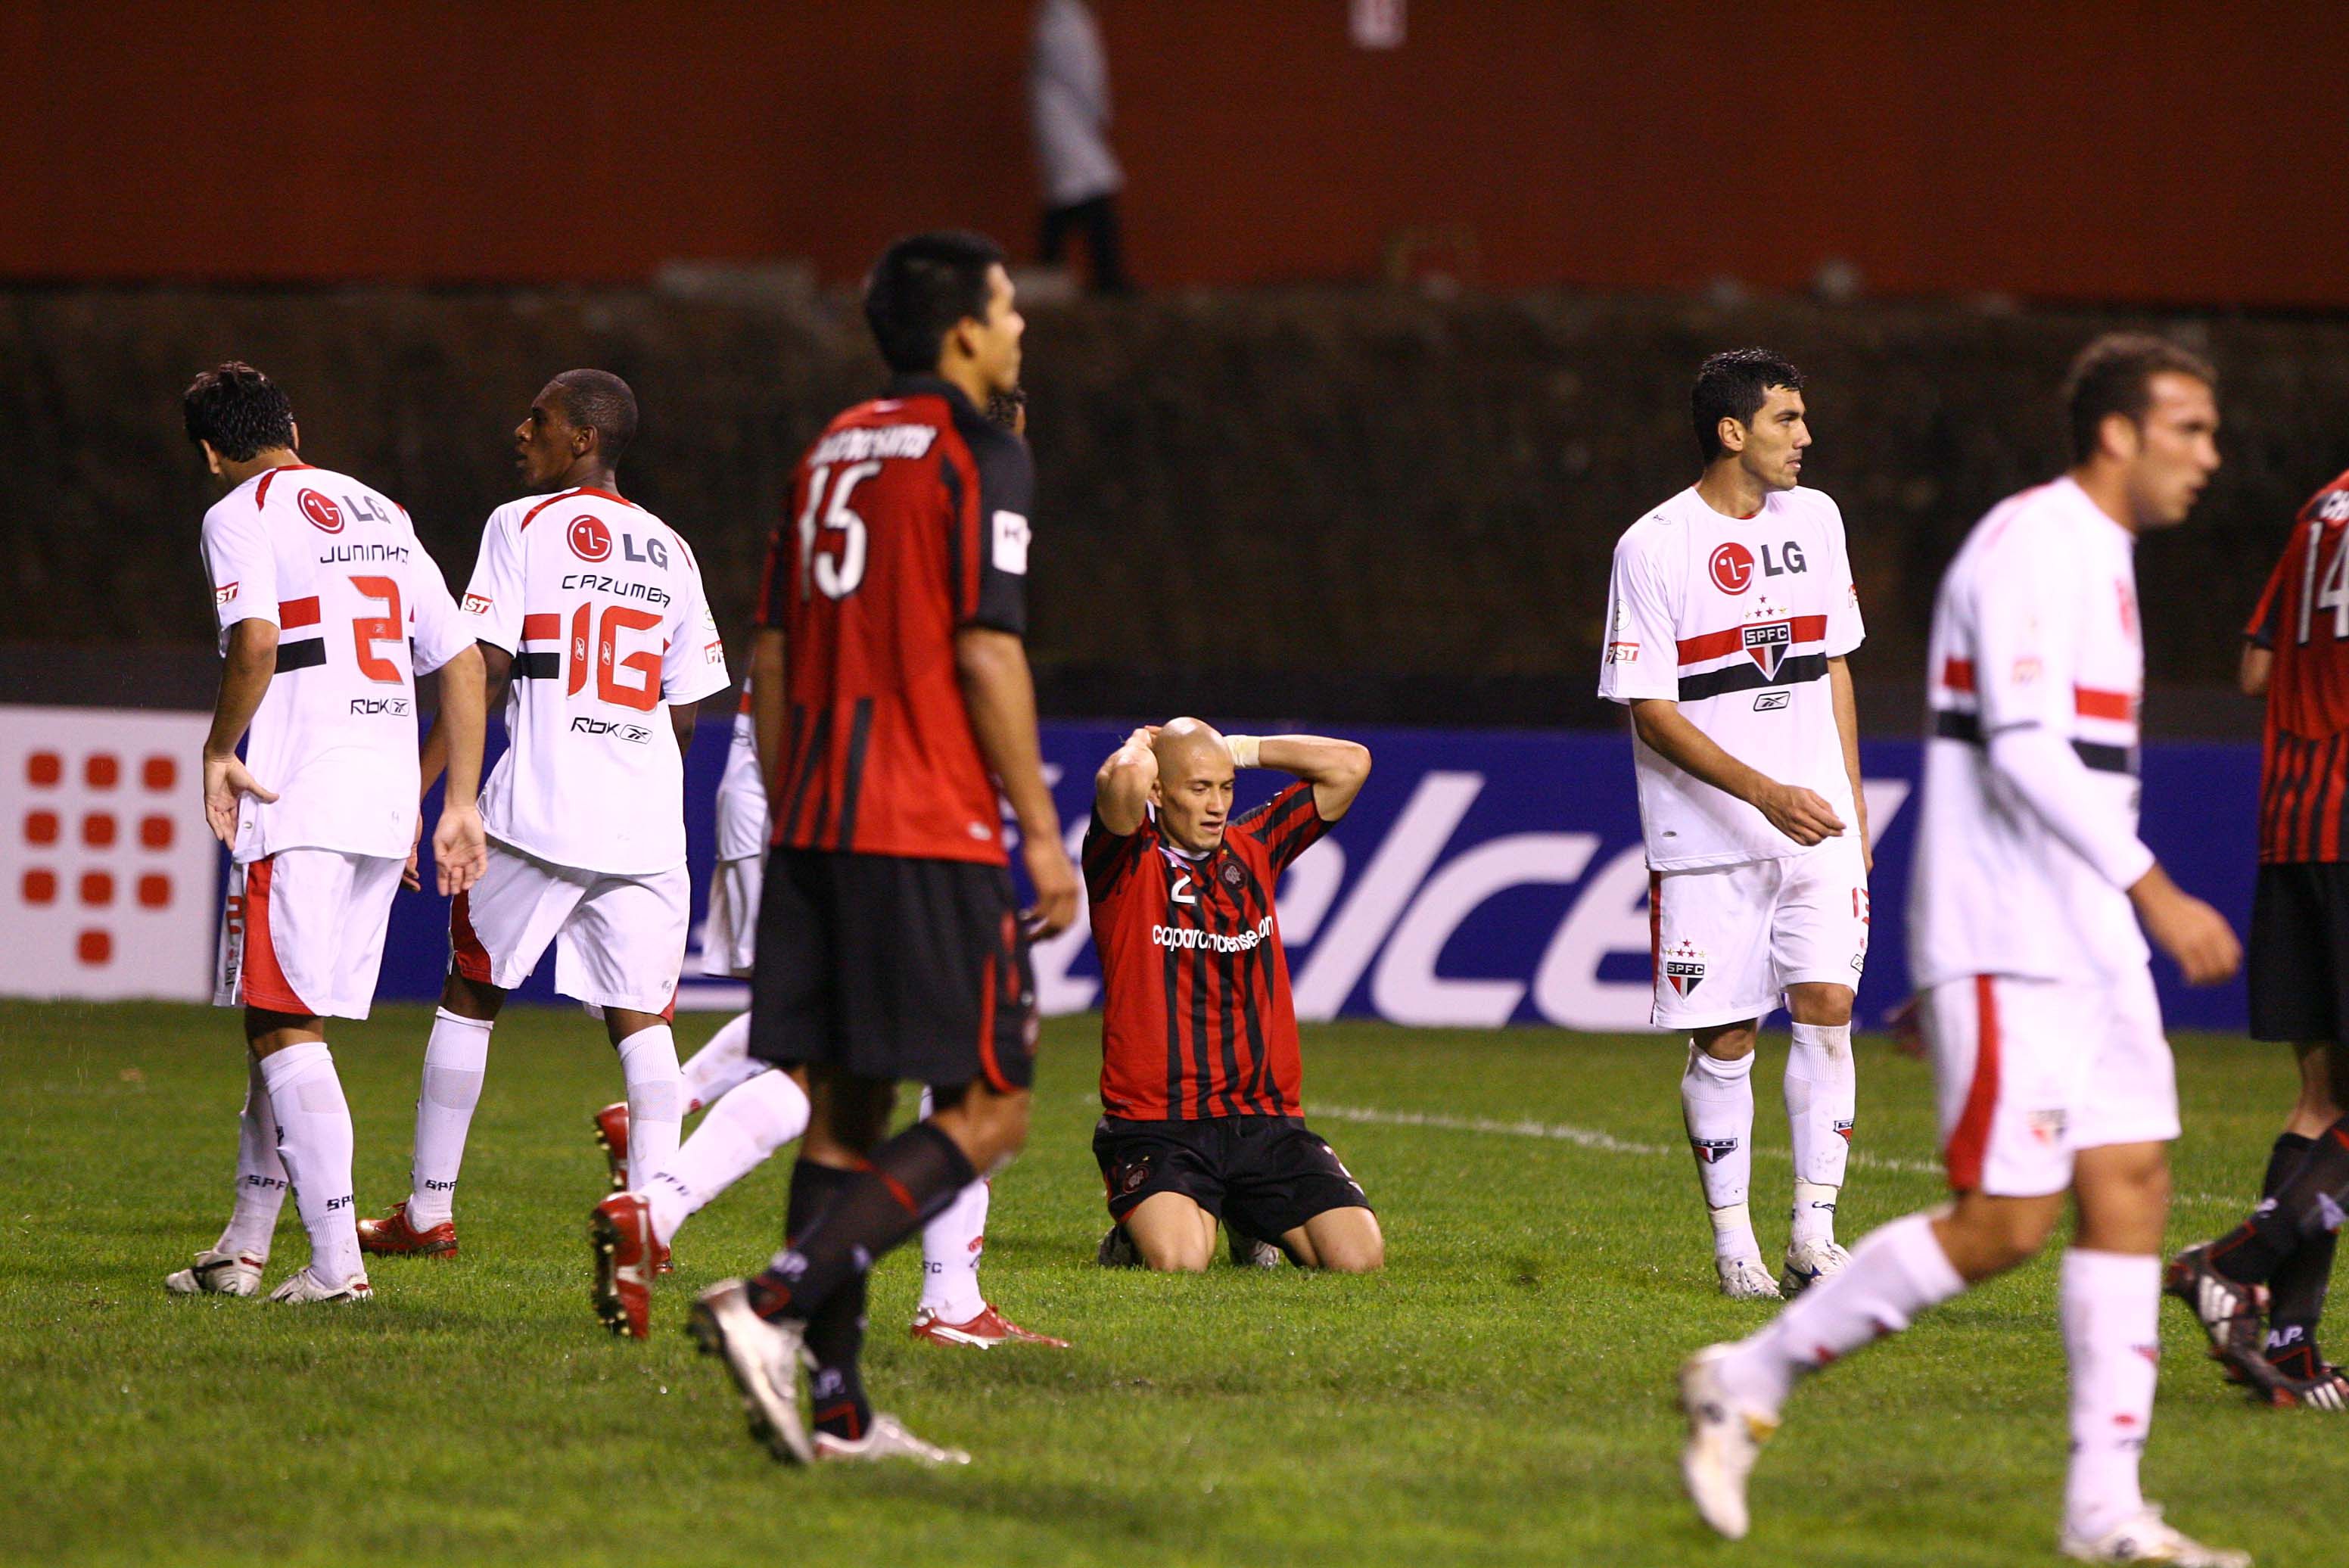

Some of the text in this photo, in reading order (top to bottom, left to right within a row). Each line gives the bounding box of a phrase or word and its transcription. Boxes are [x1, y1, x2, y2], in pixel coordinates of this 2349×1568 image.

[622, 534, 668, 571] LG
[798, 461, 883, 600] 15
[1761, 541, 1807, 577] LG
[2298, 521, 2349, 644] 14
[348, 576, 404, 685] 2
[1745, 627, 1788, 645] SPFC
[567, 601, 664, 714] 16
[1171, 859, 1196, 904] 2
[1667, 963, 1704, 975] SPFC
